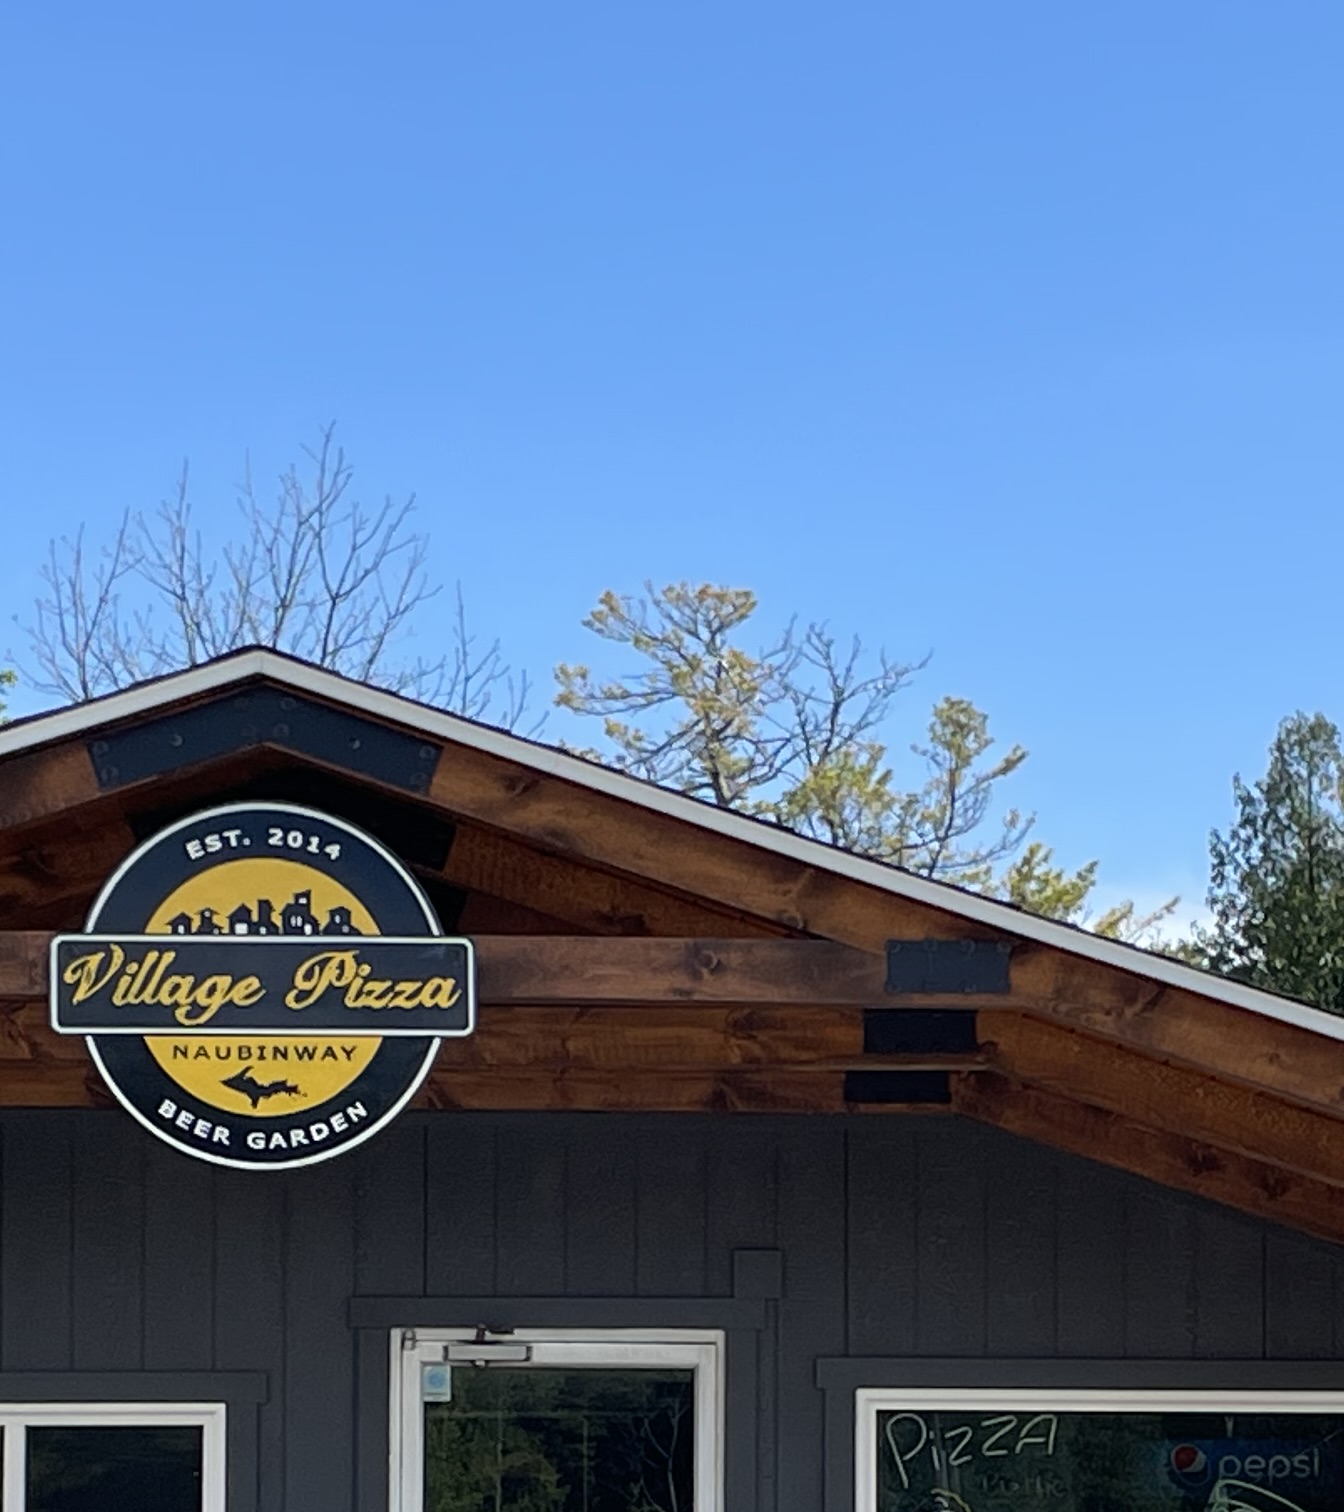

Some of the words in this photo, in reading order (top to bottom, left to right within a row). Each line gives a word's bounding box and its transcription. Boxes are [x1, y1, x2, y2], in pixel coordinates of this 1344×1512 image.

[184, 828, 251, 860] EST.
[268, 828, 342, 860] 2014
[63, 944, 266, 1026] Village
[285, 949, 462, 1011] Pizza
[172, 1044, 358, 1062] NAUBINWAY
[157, 1098, 231, 1146] BEER
[246, 1101, 369, 1150] GARDEN
[1219, 1446, 1320, 1486] pepsi
